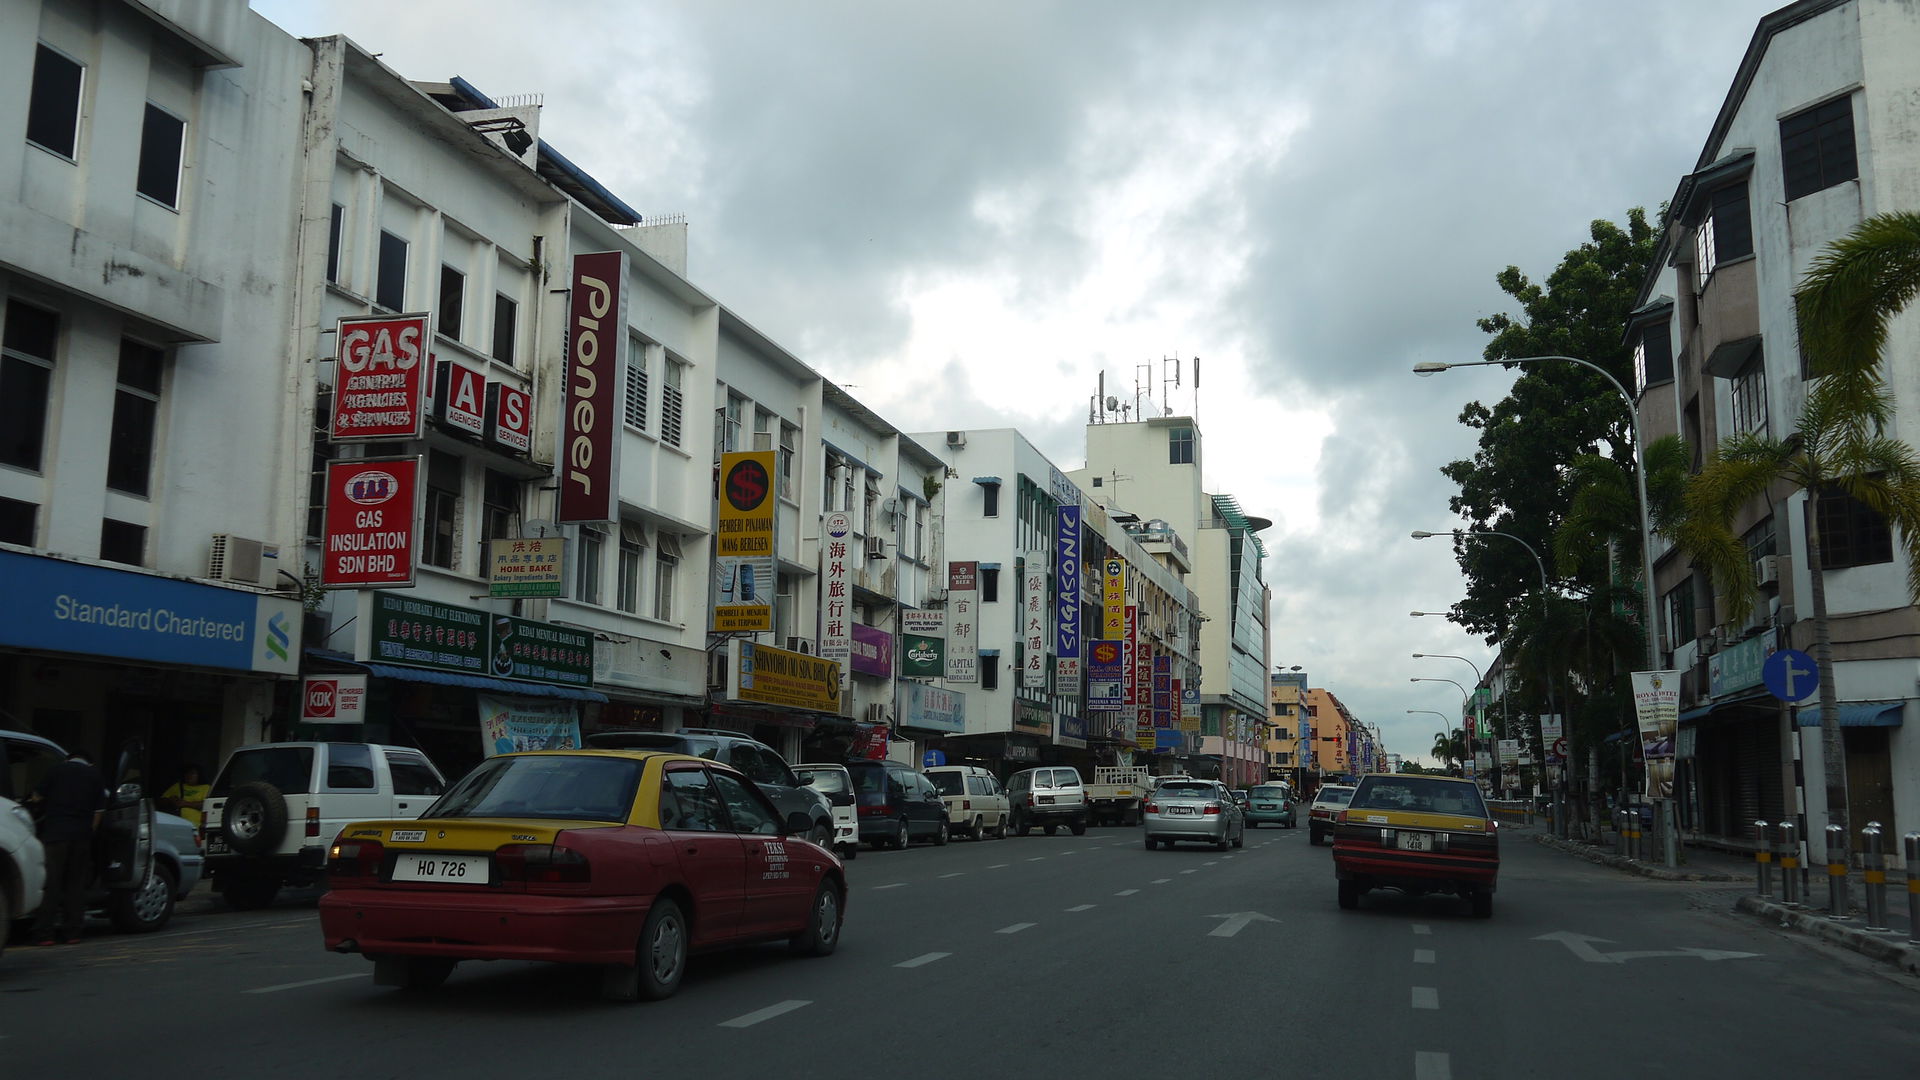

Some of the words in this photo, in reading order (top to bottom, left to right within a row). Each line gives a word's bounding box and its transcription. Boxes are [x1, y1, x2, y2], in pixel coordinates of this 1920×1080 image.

[342, 326, 419, 373] GAS
[455, 372, 477, 414] A
[571, 274, 612, 496] pioneer
[449, 411, 481, 430] AGENCIES
[505, 392, 523, 430] S
[499, 429, 527, 448] SERVICES
[356, 510, 383, 528] GAS
[719, 517, 744, 533] PEMBERI
[745, 517, 773, 533] PINJAMAN
[331, 532, 406, 552] INSULATION
[721, 538, 738, 552] WANG
[739, 537, 769, 552] BERLESEN
[338, 556, 365, 574] SDN
[367, 554, 395, 573] BHD
[500, 565, 526, 573] HOME
[529, 564, 553, 572] BAKE
[827, 542, 846, 637] 海外旅行社
[1060, 511, 1078, 651] SAGASONIC
[54, 594, 151, 631] Standard
[154, 608, 244, 642] Chartered
[954, 598, 971, 638] 首都
[518, 625, 535, 638] KEDAI
[908, 649, 938, 660] Carlsberg
[948, 659, 974, 668] CAPITAL
[1124, 608, 1133, 701] PENSONIC
[309, 690, 332, 708] KDK
[341, 695, 358, 703] SERVICE
[341, 702, 358, 710] CENTRE
[764, 842, 785, 855] TEKSI
[417, 860, 434, 876] HQ
[441, 861, 466, 877] 726
